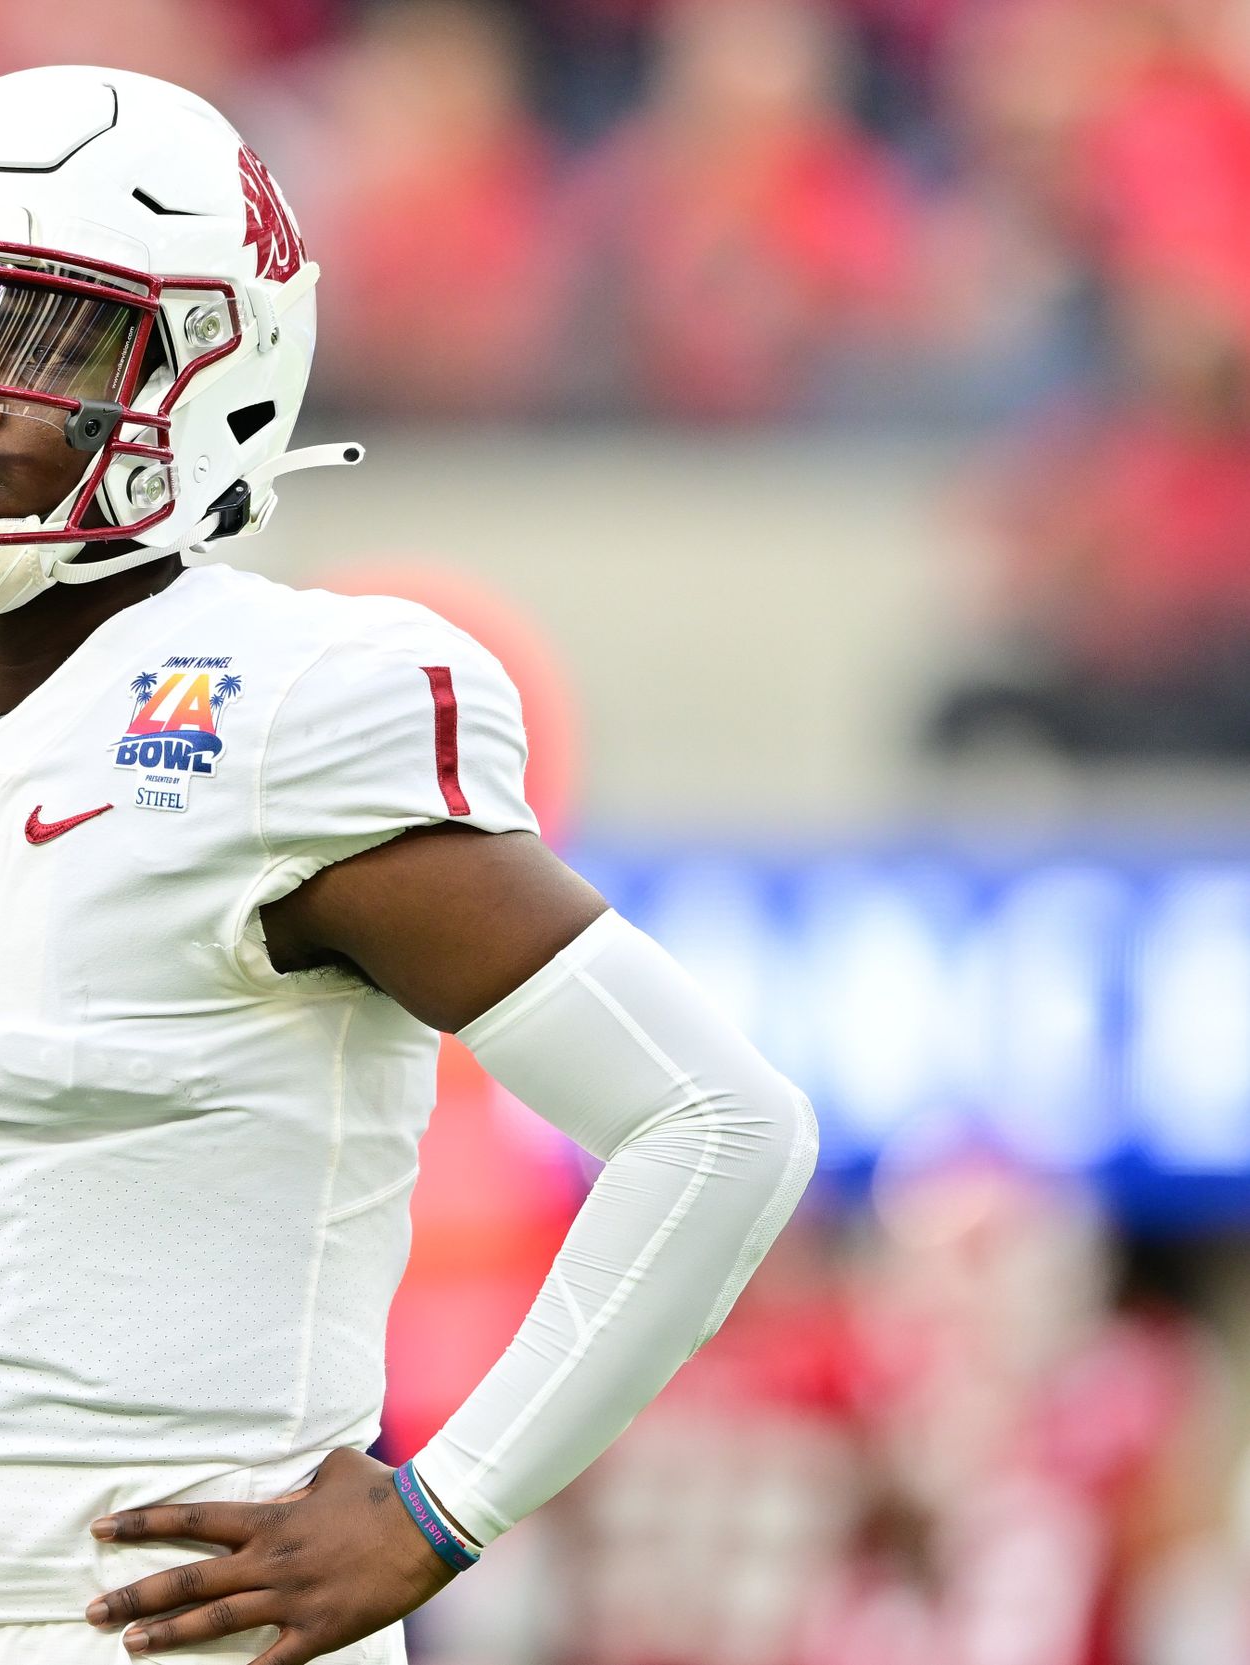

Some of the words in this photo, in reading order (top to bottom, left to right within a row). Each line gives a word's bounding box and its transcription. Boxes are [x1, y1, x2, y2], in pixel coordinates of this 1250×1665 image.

[112, 326, 135, 389] www.nikevision.com
[161, 656, 198, 668] JIMMY
[193, 656, 233, 668] KIMMEL
[125, 673, 216, 735] LA
[115, 736, 212, 774] BOWL
[419, 666, 471, 816] 1
[145, 774, 173, 784] PRESENTED
[135, 787, 184, 809] STIFEL
[397, 1462, 412, 1493] Goin
[408, 1490, 430, 1523] Keep
[424, 1519, 448, 1546] Just
